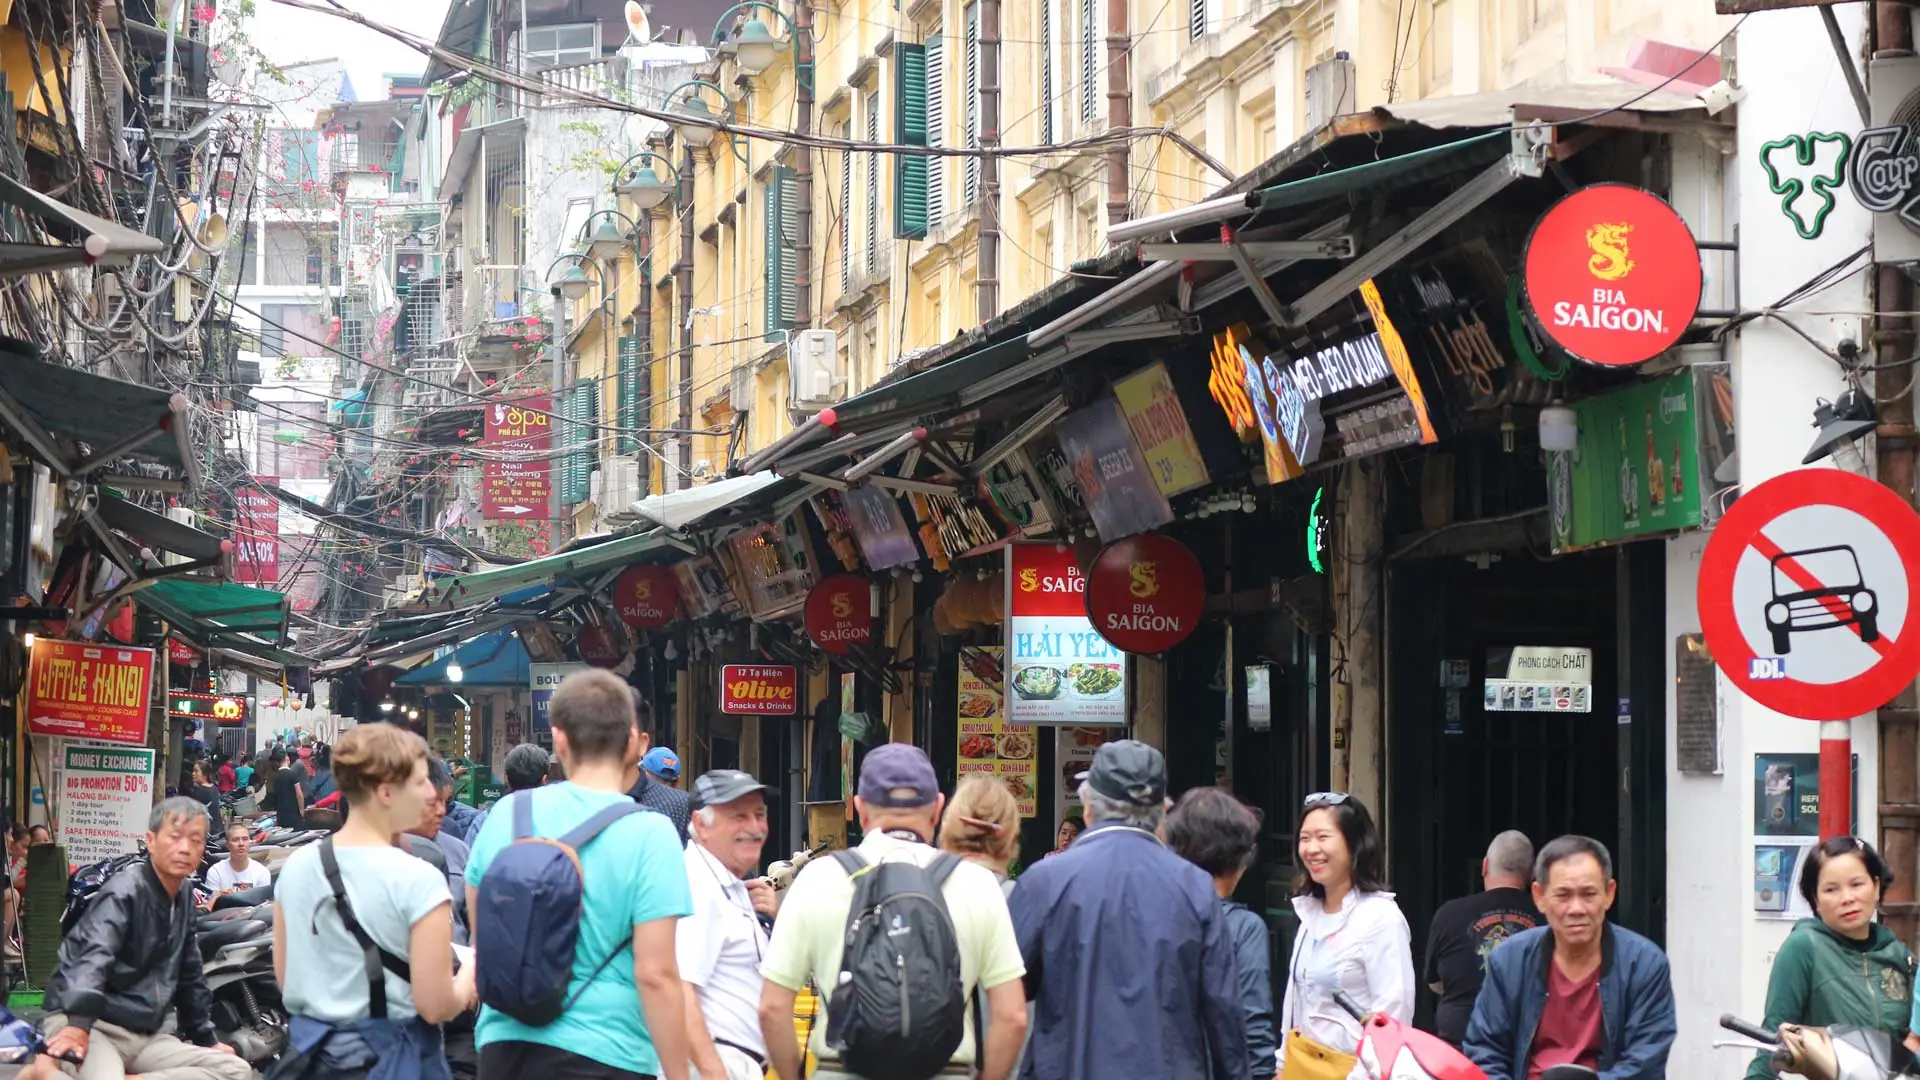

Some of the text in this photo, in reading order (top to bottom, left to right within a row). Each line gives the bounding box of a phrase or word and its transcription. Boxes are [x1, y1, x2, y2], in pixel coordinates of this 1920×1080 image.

[1593, 287, 1626, 305] BIA
[1554, 301, 1662, 333] SAIGON
[507, 407, 547, 435] Spa
[501, 470, 541, 479] Waxing
[1042, 577, 1086, 592] SAIG
[623, 607, 663, 618] SAIGON
[1133, 604, 1154, 614] BIA
[1107, 613, 1179, 632] SAIGON
[820, 627, 869, 641] SAIGON
[1518, 656, 1541, 669] PHONG
[738, 668, 747, 677] 17
[37, 657, 144, 707] LITTLE HANOI
[727, 680, 793, 700] Olive
[728, 702, 756, 710] Snacks
[70, 753, 148, 771] MONEY EXCHANGE
[67, 775, 148, 793] BIG PROMOTION 50%
[66, 791, 95, 801] HALONG
[97, 792, 111, 801] BAY
[76, 801, 88, 809] day
[1801, 805, 1819, 814] SOL
[76, 810, 92, 819] days
[98, 811, 116, 820] night
[76, 818, 92, 827] days
[64, 827, 83, 836] SAPA
[84, 828, 119, 839] TREKKING
